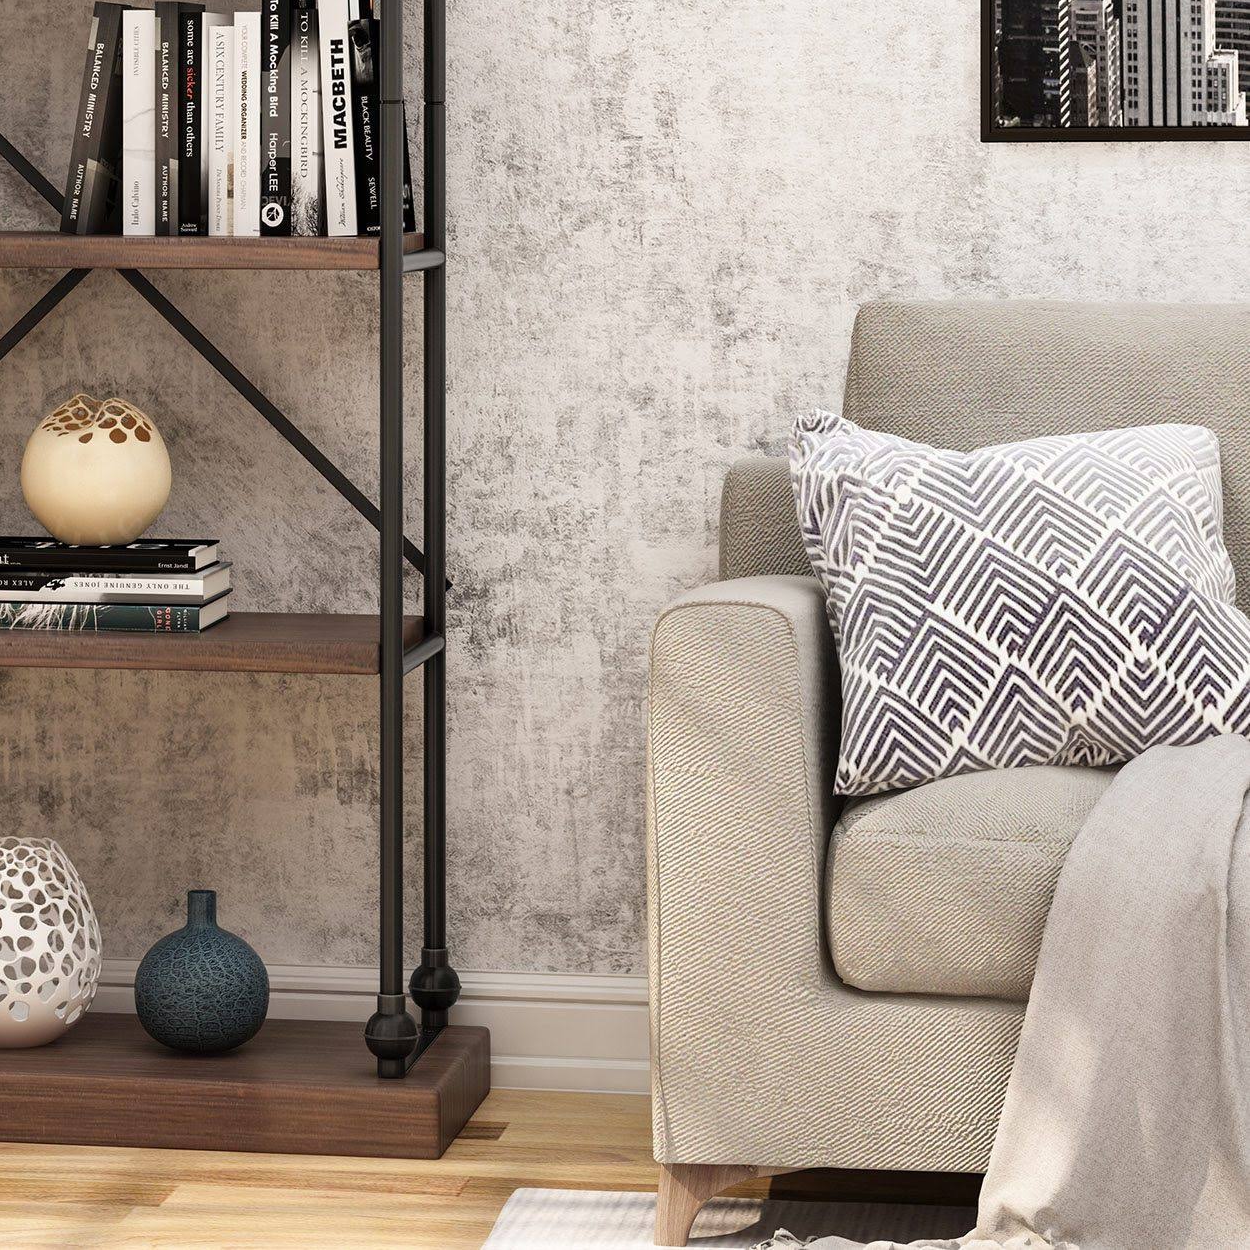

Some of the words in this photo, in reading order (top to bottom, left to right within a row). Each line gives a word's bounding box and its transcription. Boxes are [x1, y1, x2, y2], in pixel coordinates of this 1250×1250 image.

[186, 19, 195, 47] some
[215, 32, 225, 40] A
[269, 14, 280, 31] Kill
[300, 12, 309, 32] TO
[215, 40, 225, 57] SIX
[269, 33, 279, 42] A
[300, 35, 309, 63] KILL
[90, 42, 105, 90] BALANCED
[161, 41, 170, 90] BALANCED
[186, 49, 195, 65] are
[268, 44, 280, 93] Mocking
[186, 67, 196, 100] sicker
[215, 60, 225, 110] CENTURY
[300, 67, 309, 76] A
[240, 70, 248, 102] WEDDING
[330, 39, 347, 149] MACBETH
[82, 93, 97, 138] MINISTRY
[161, 93, 170, 139] MINISTRY
[186, 101, 196, 124] than
[269, 96, 280, 117] Bird
[361, 95, 370, 124] BLACK
[215, 112, 225, 152] FAMILY
[240, 102, 248, 140] ORGANIZER
[300, 79, 309, 179] MOCKINGBIRD
[185, 126, 196, 158] others
[266, 133, 279, 171] Harper
[363, 125, 374, 161] BEAUTY
[72, 163, 85, 195] AUTHOR
[161, 165, 169, 197] AUTHOR
[268, 173, 279, 191] LEE
[367, 176, 378, 210] SEWELL
[131, 181, 140, 208] Calvino
[69, 198, 79, 220] NAME
[131, 209, 140, 226] Italo
[161, 199, 169, 222] NAME
[12, 579, 34, 587] ALEX
[73, 581, 101, 589] JONES
[103, 582, 143, 590] GENUINE
[173, 583, 190, 591] THE
